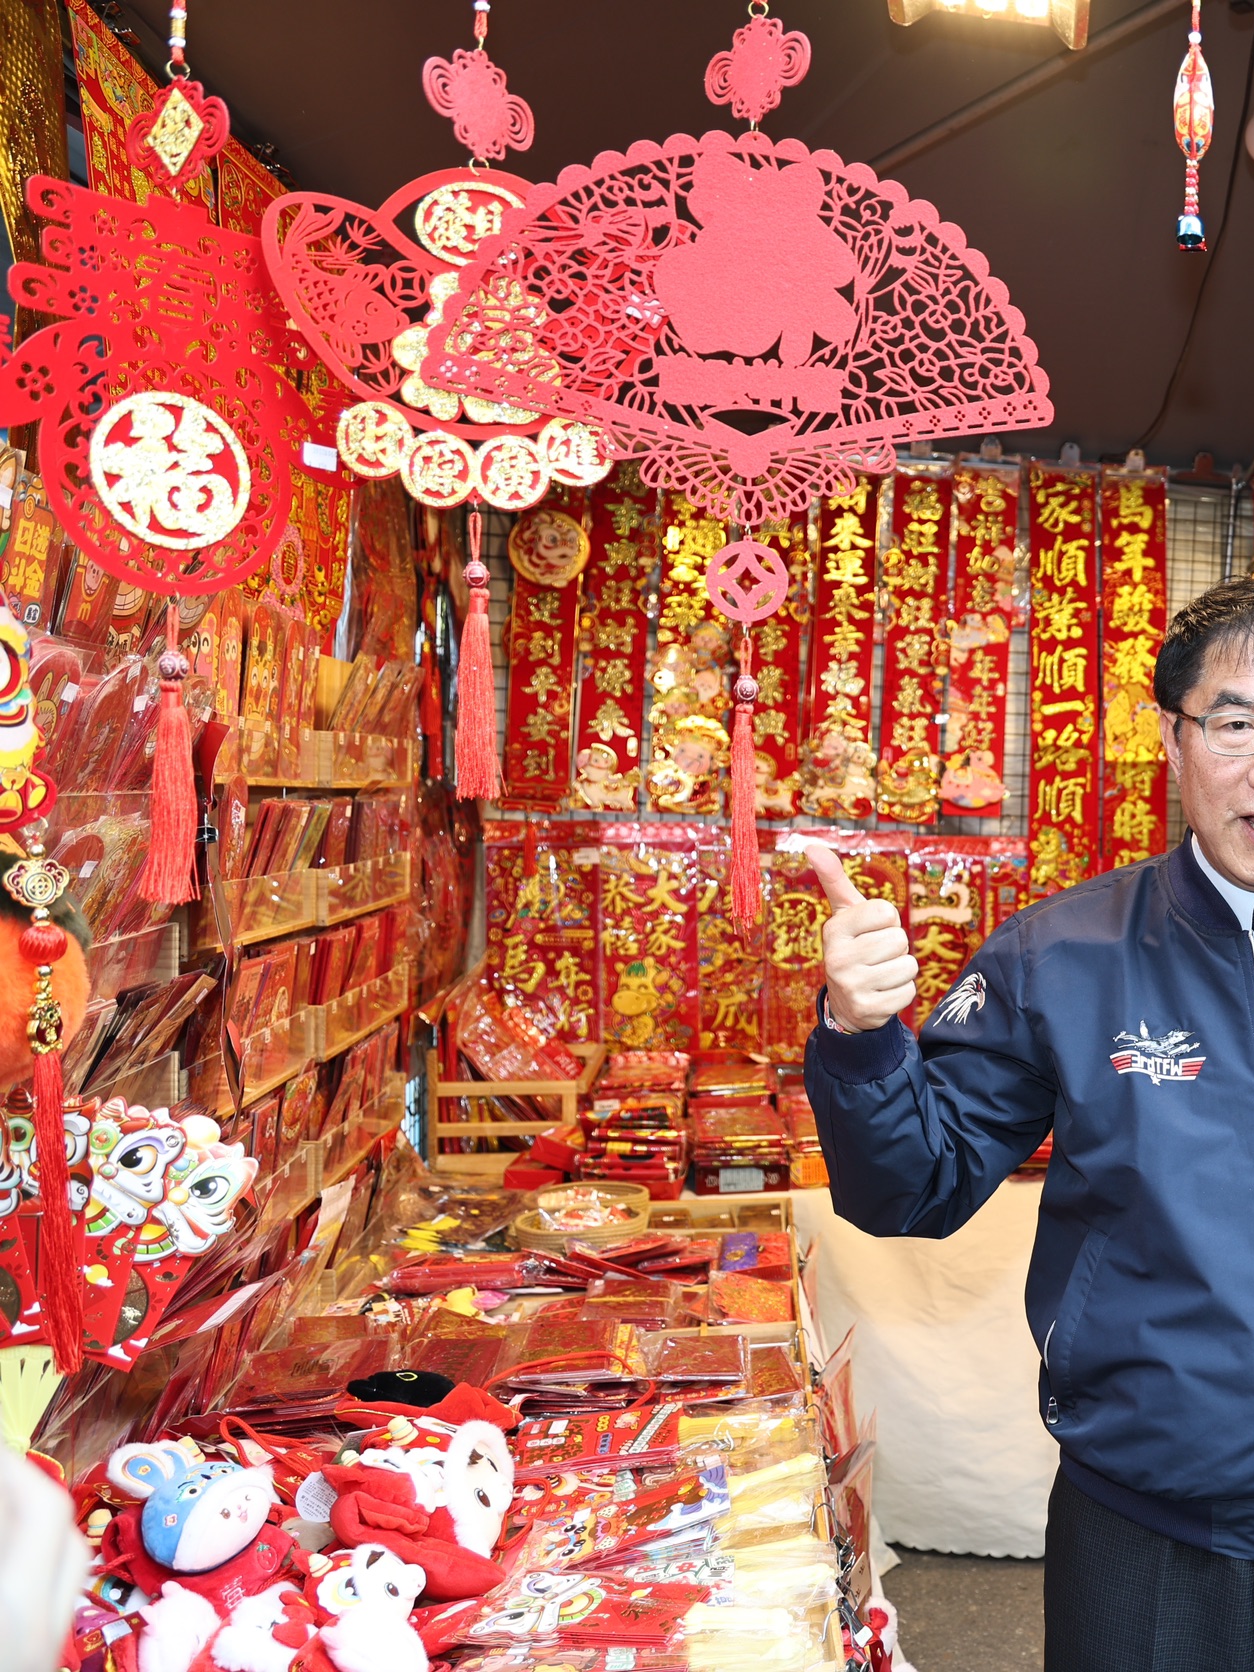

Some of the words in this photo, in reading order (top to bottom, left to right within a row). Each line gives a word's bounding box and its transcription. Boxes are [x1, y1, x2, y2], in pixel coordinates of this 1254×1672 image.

[102, 402, 236, 534] 福
[8, 557, 45, 599] 斗金
[965, 475, 1009, 613] 吉祥如意
[1033, 483, 1091, 825] 家順業順一路順
